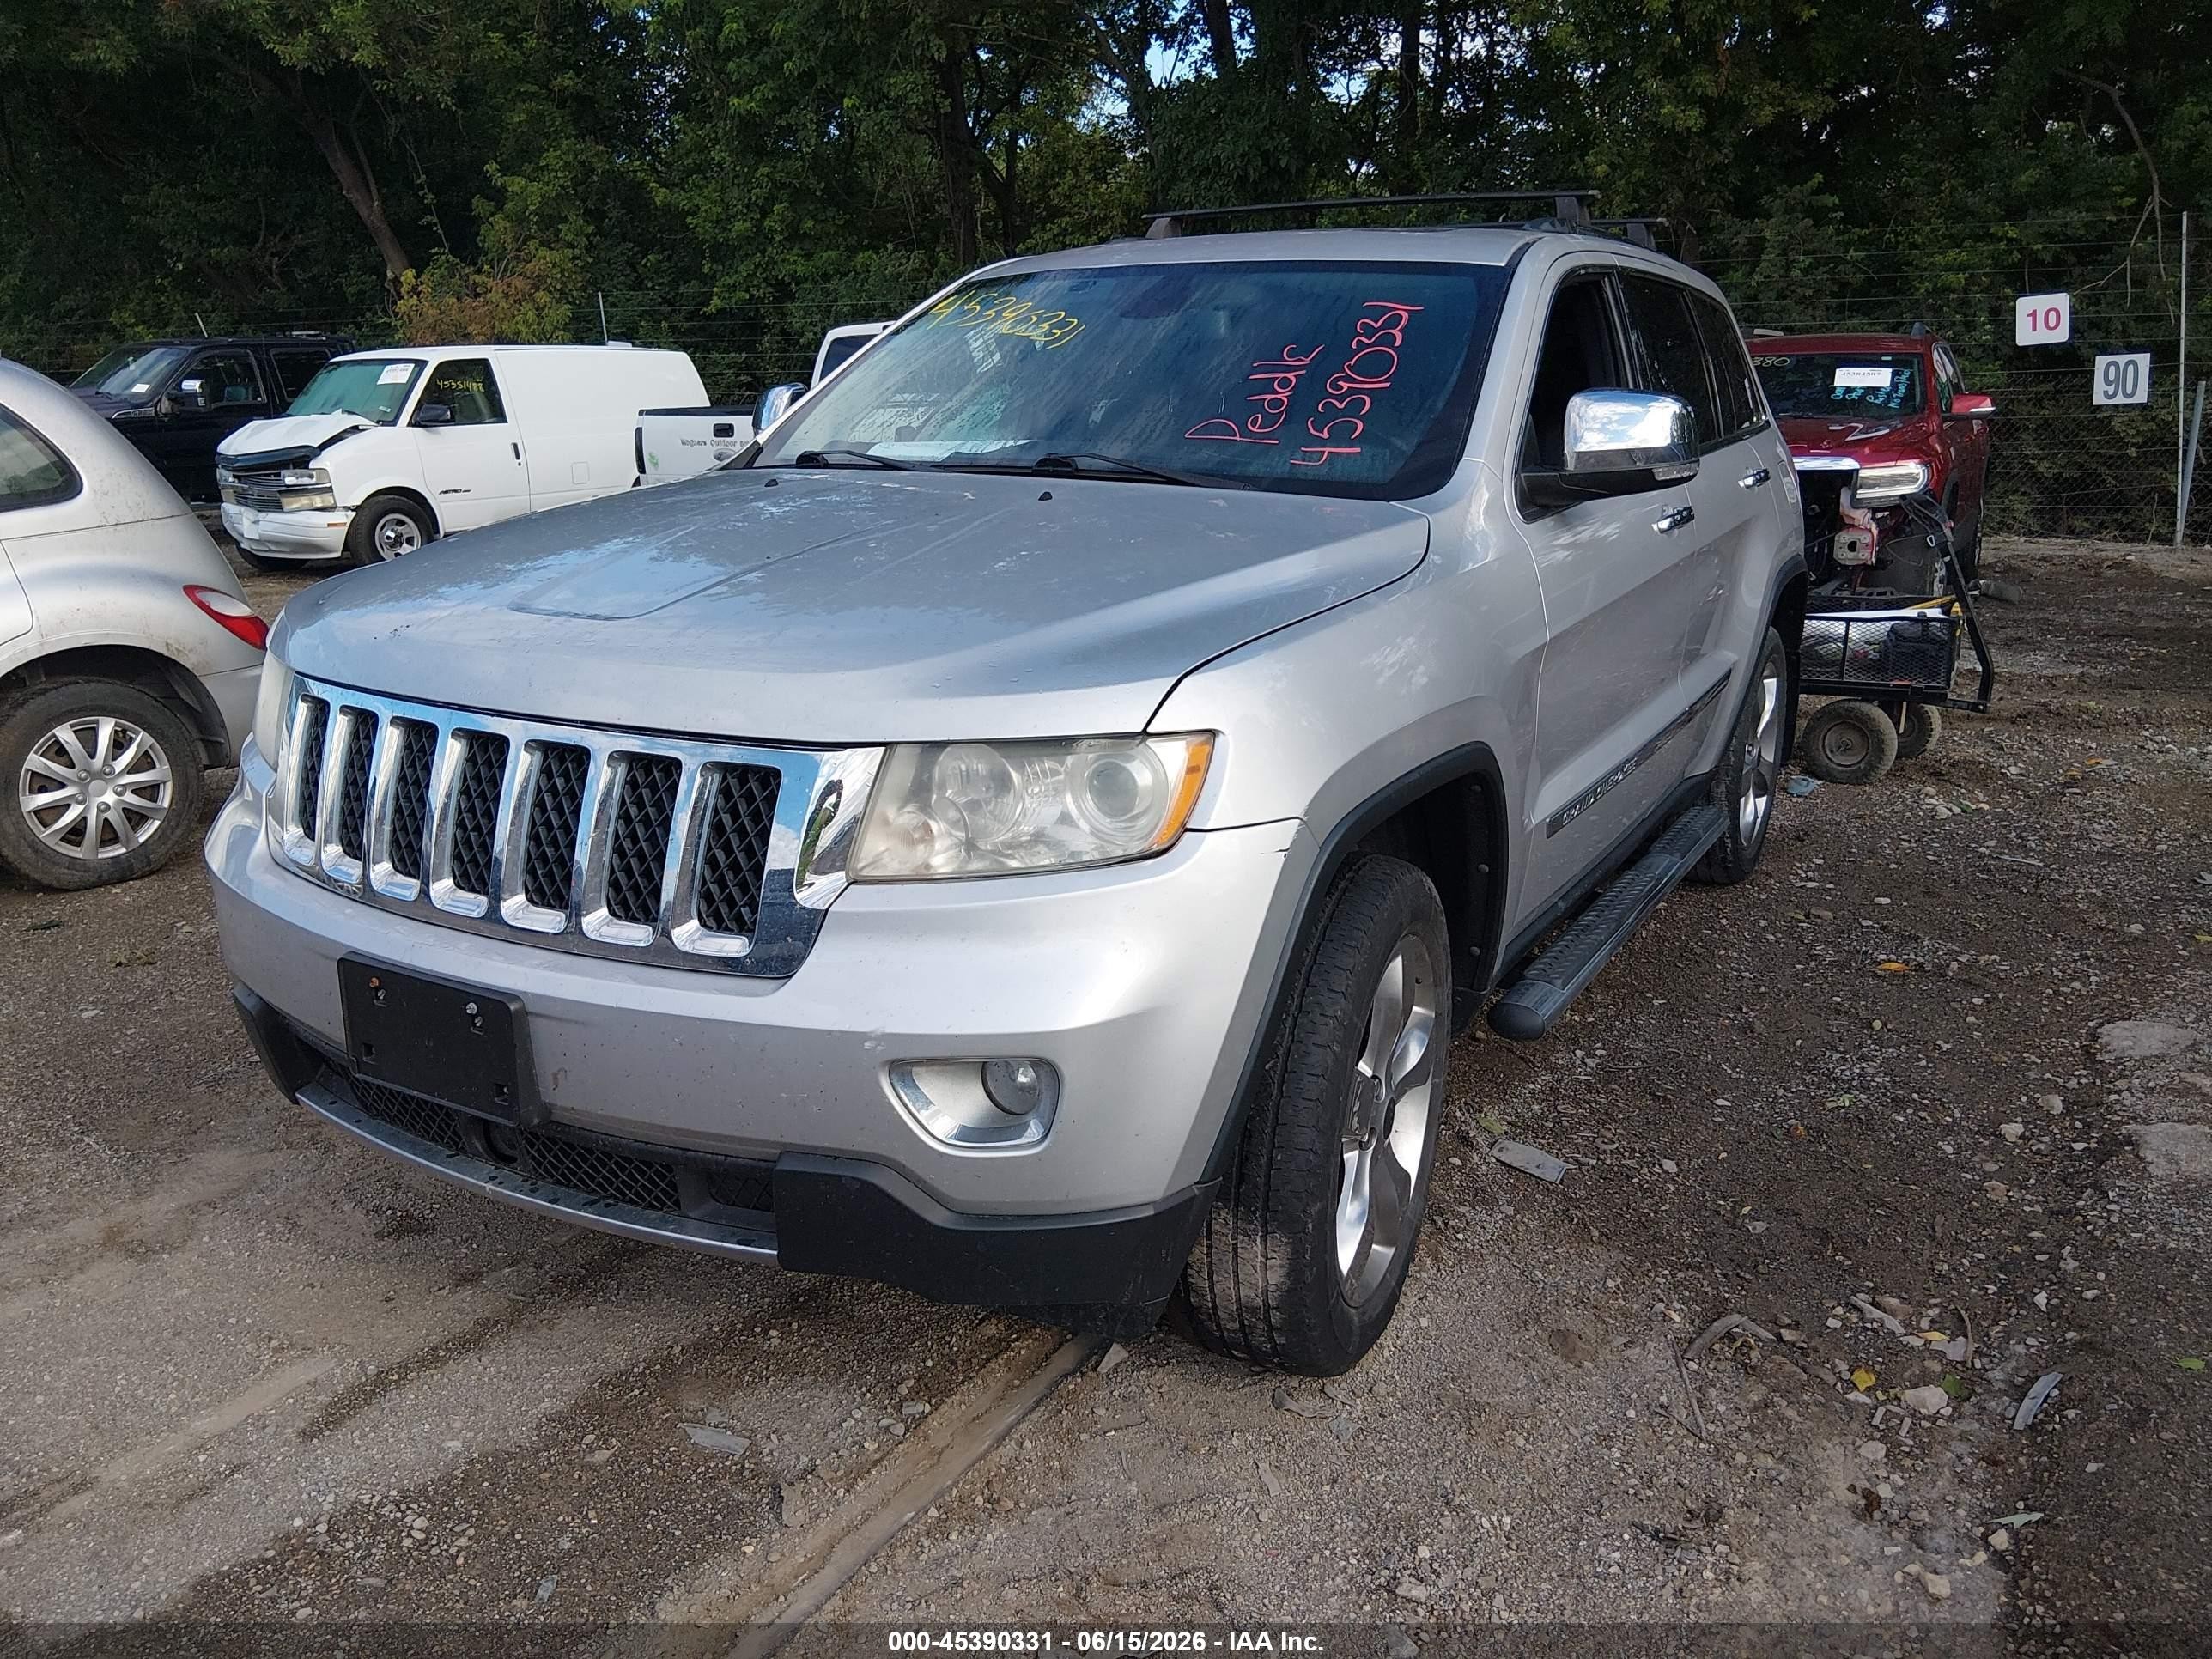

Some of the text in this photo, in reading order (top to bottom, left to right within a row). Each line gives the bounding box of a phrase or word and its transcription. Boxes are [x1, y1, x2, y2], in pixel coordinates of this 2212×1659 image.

[927, 289, 1086, 349] 45390331
[2026, 307, 2062, 332] 10
[1289, 301, 1425, 465] 45390331
[2102, 358, 2140, 401] 90
